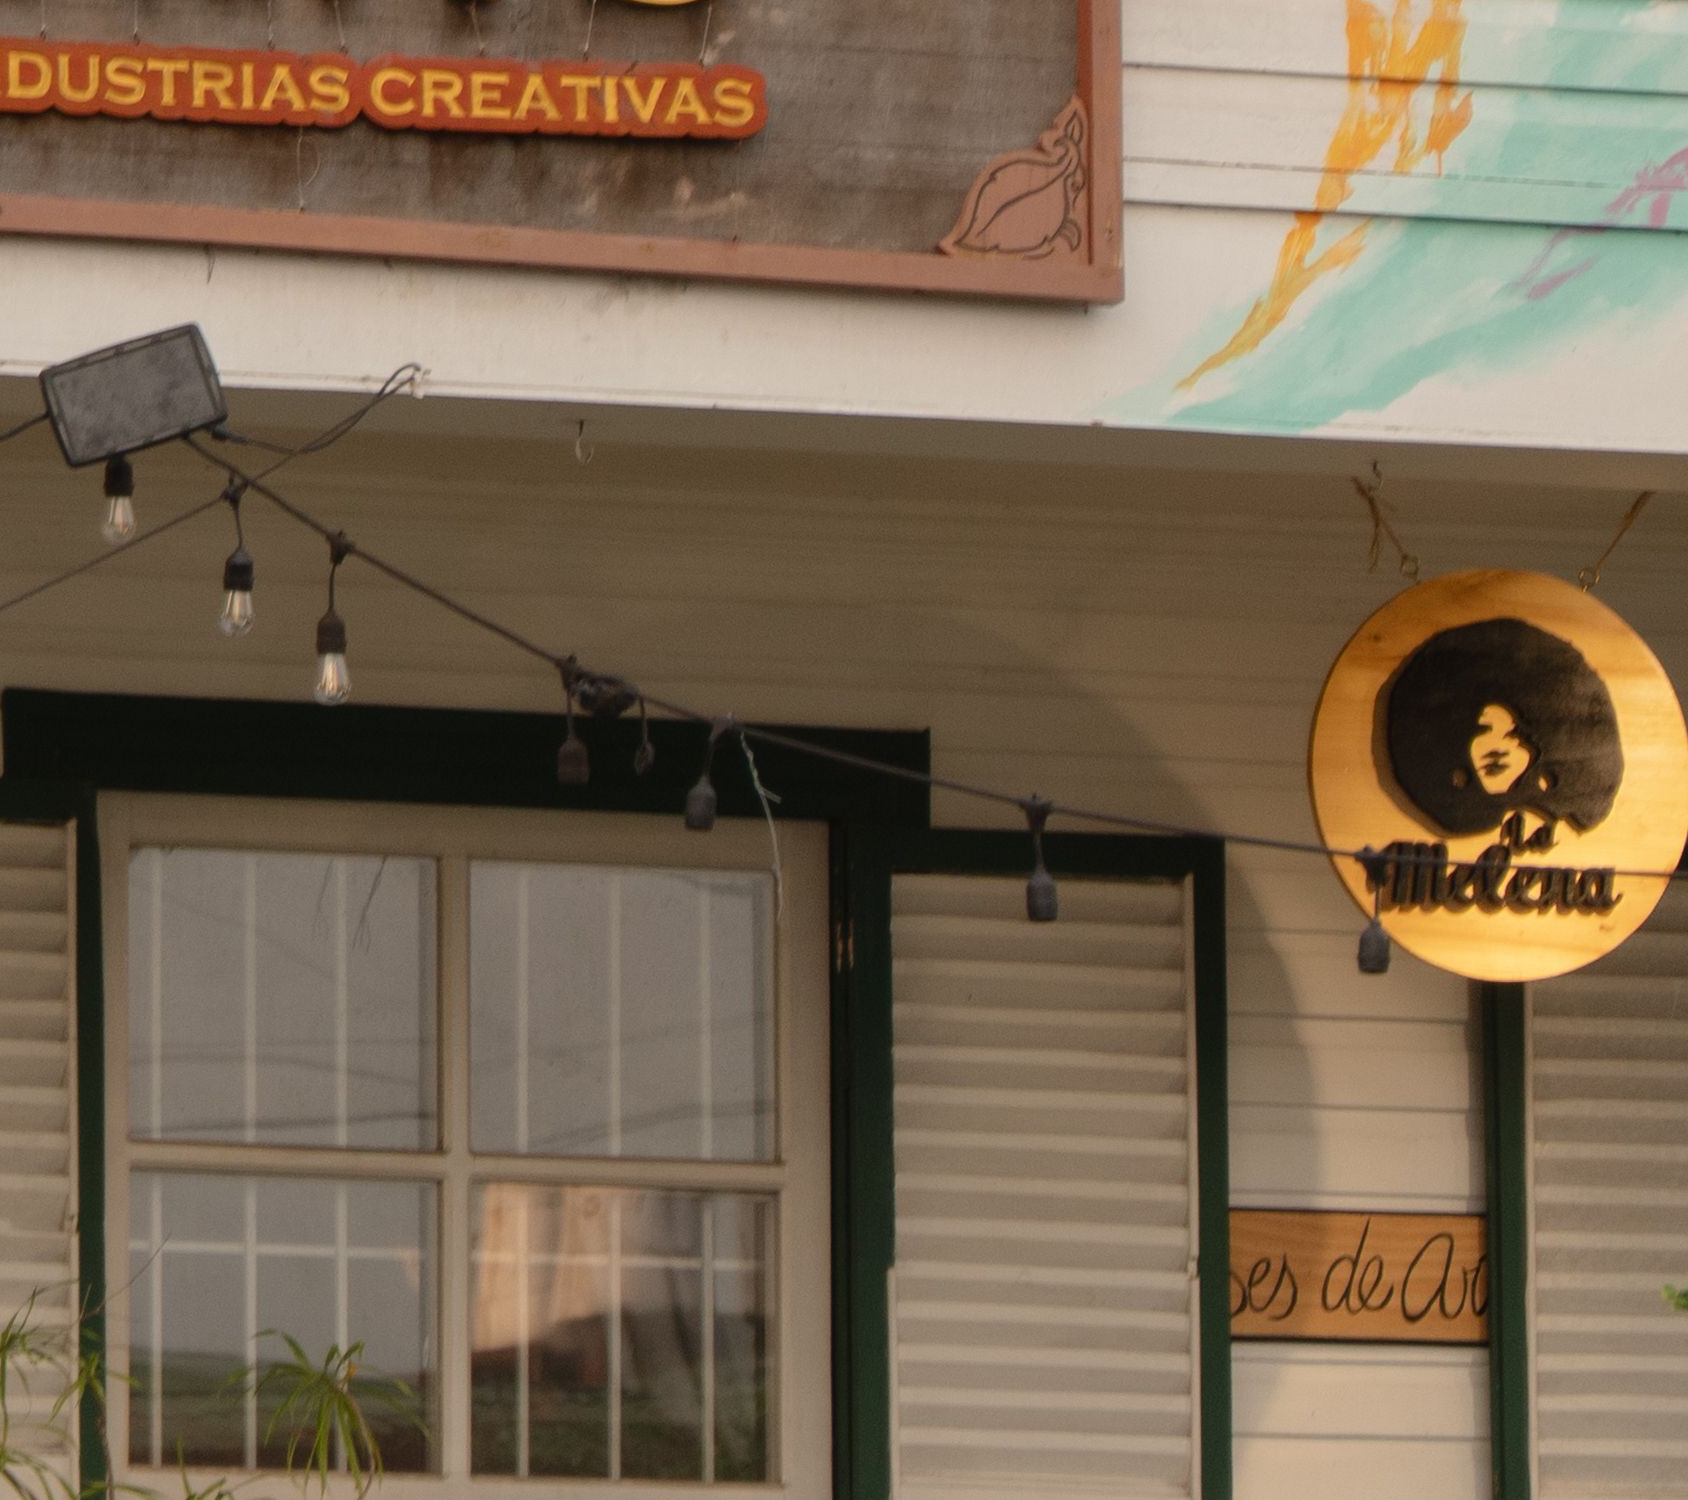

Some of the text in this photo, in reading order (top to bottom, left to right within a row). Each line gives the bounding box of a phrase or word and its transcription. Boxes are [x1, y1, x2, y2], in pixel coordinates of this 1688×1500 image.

[369, 66, 758, 129] CREATIVAS
[1380, 840, 1624, 915] Melena
[1321, 1216, 1395, 1316] de
